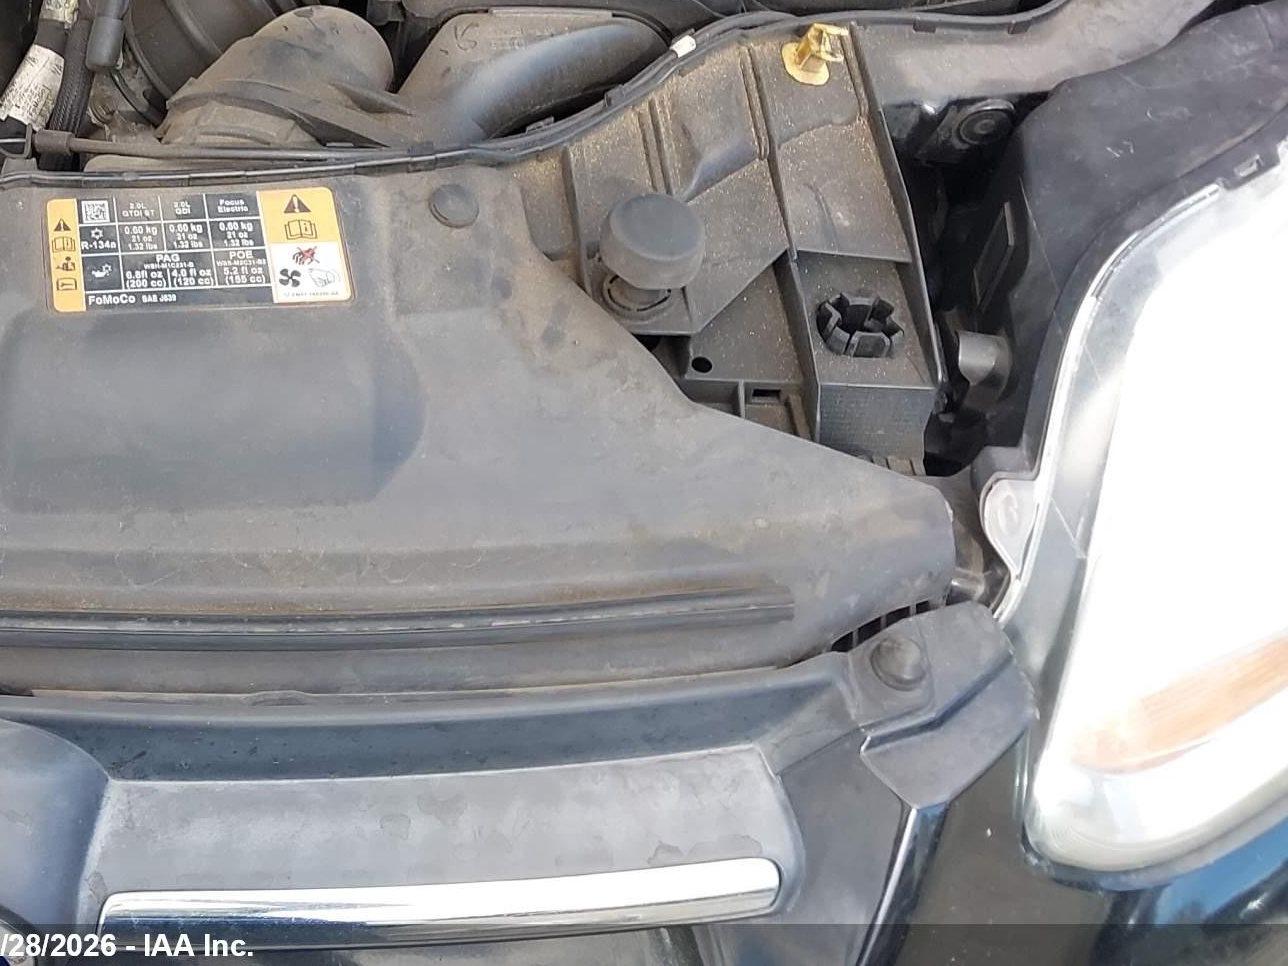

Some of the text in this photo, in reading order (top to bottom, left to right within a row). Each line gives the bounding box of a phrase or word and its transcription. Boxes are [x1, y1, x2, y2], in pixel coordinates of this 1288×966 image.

[217, 205, 249, 213] Electric
[145, 226, 158, 237] kg
[190, 223, 203, 234] kg
[240, 222, 253, 232] kg
[81, 240, 117, 251] R-134a
[155, 253, 180, 263] PAG
[229, 250, 254, 260] POE
[150, 270, 163, 279] oz
[171, 268, 187, 277] 4.0
[189, 268, 197, 277] fl
[223, 267, 239, 276] 5.2
[240, 266, 249, 275] fl
[126, 278, 167, 289] (200 cc)
[173, 276, 214, 287] (120 cc)
[249, 274, 266, 284] cc)
[88, 294, 136, 306] FoMoCo
[142, 295, 158, 303] SAE
